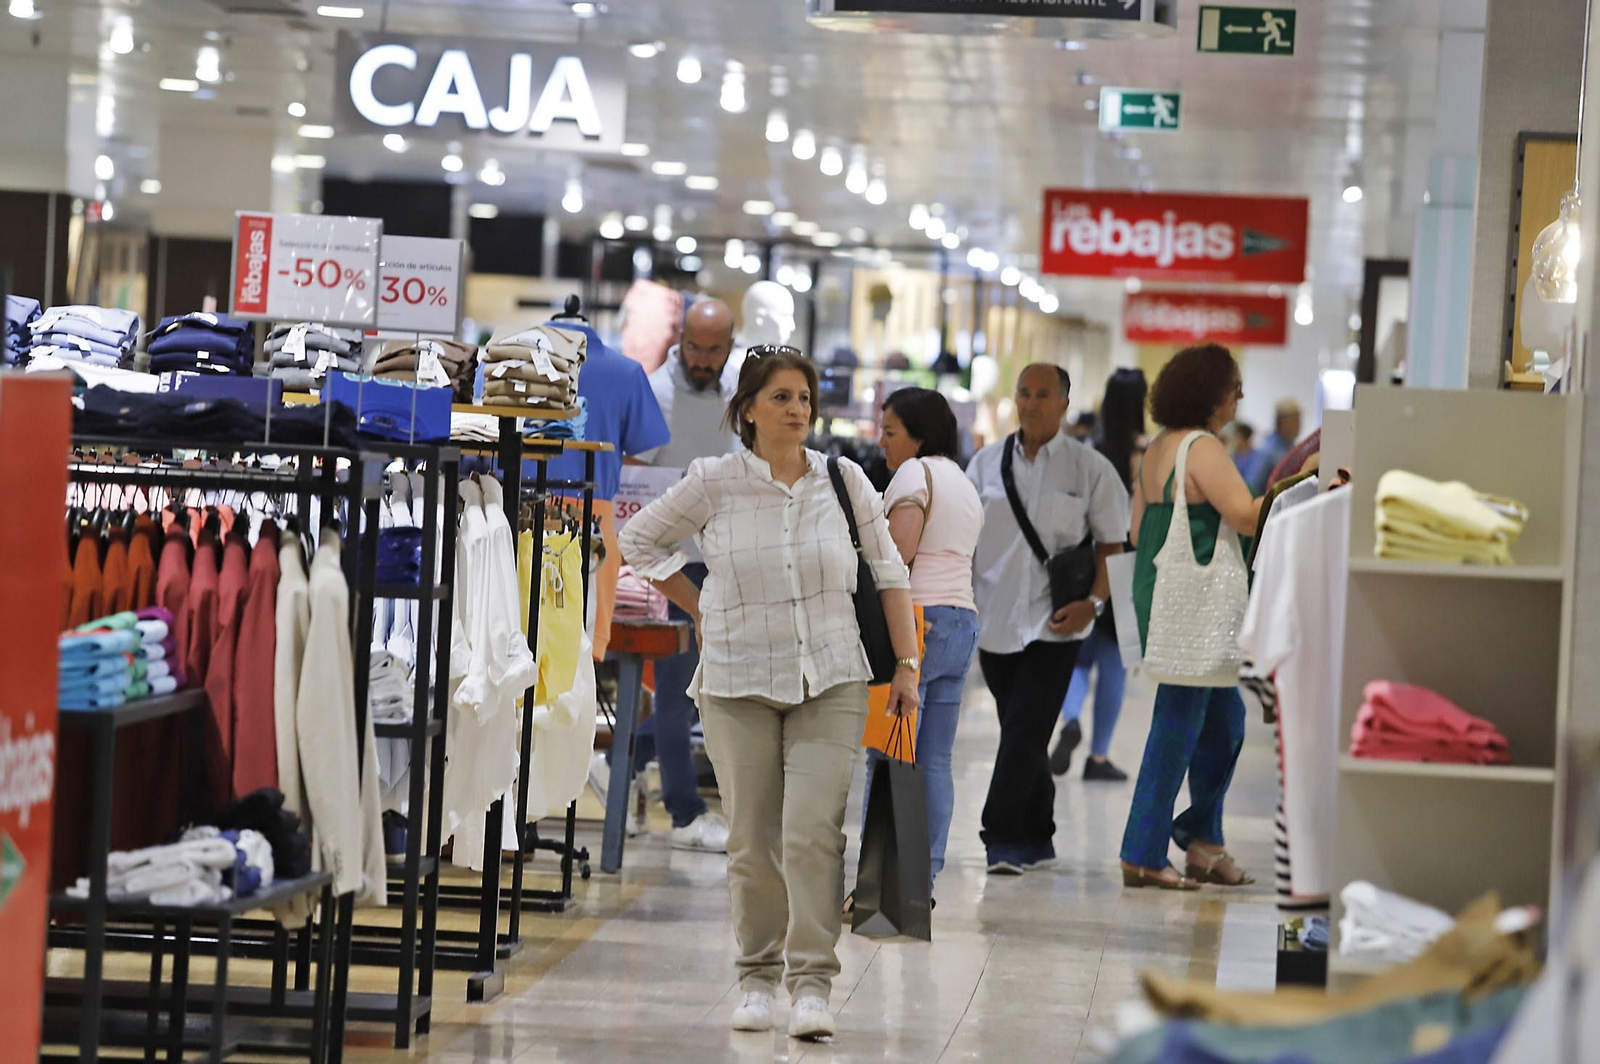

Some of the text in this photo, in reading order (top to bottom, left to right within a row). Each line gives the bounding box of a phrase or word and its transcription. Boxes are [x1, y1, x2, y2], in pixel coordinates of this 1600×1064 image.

[350, 44, 601, 136] CAJA
[244, 230, 267, 303] rebajas
[1051, 208, 1235, 267] rebajas
[278, 258, 367, 291] -50%
[381, 276, 448, 307] 30%
